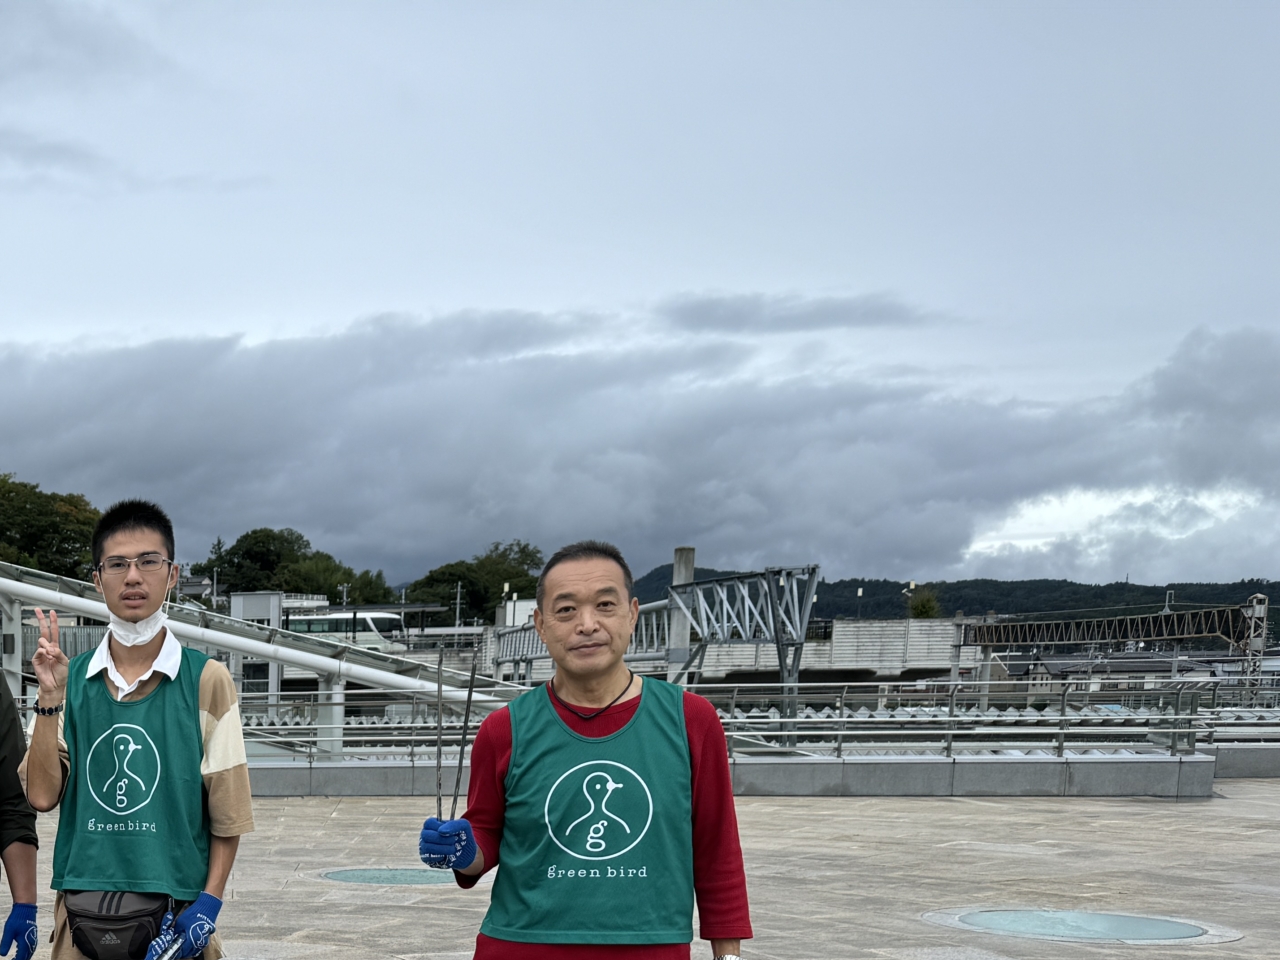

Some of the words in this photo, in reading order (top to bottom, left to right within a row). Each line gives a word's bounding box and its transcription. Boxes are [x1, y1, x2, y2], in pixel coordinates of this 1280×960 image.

[87, 818, 124, 832] green
[128, 820, 156, 832] bird
[547, 864, 600, 879] green
[606, 866, 648, 878] bird
